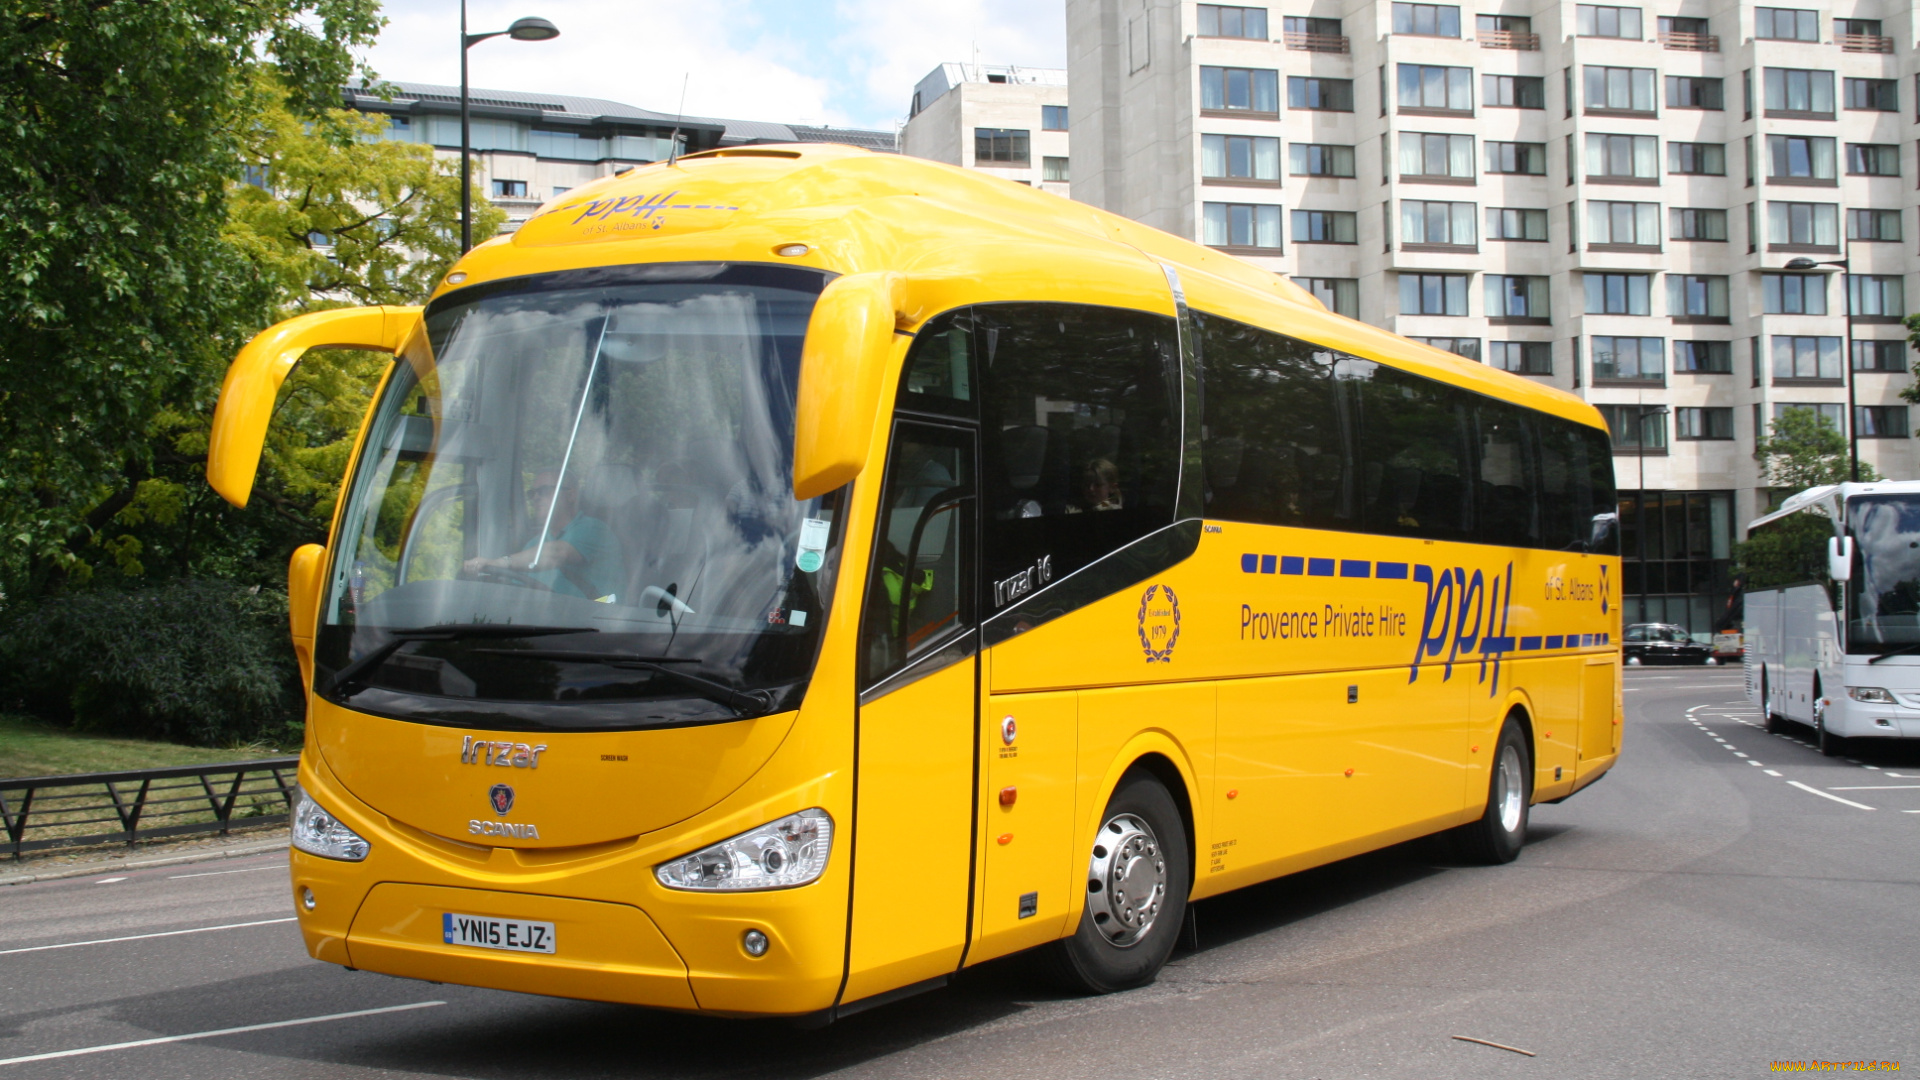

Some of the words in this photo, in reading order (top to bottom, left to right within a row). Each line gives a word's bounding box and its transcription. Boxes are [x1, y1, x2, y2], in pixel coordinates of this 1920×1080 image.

[582, 226, 593, 235] of
[596, 224, 608, 234] St.
[612, 221, 647, 231] Albans
[1204, 525, 1222, 534] SCANIA
[1037, 554, 1052, 585] i6
[1569, 577, 1594, 601] Albans
[1152, 625, 1167, 640] 1979
[1241, 604, 1318, 640] Provence
[1324, 604, 1374, 638] Private
[1379, 605, 1406, 637] Hire
[461, 735, 548, 769] Irizar
[468, 819, 540, 840] SCANIA
[506, 923, 546, 949] EJZ
